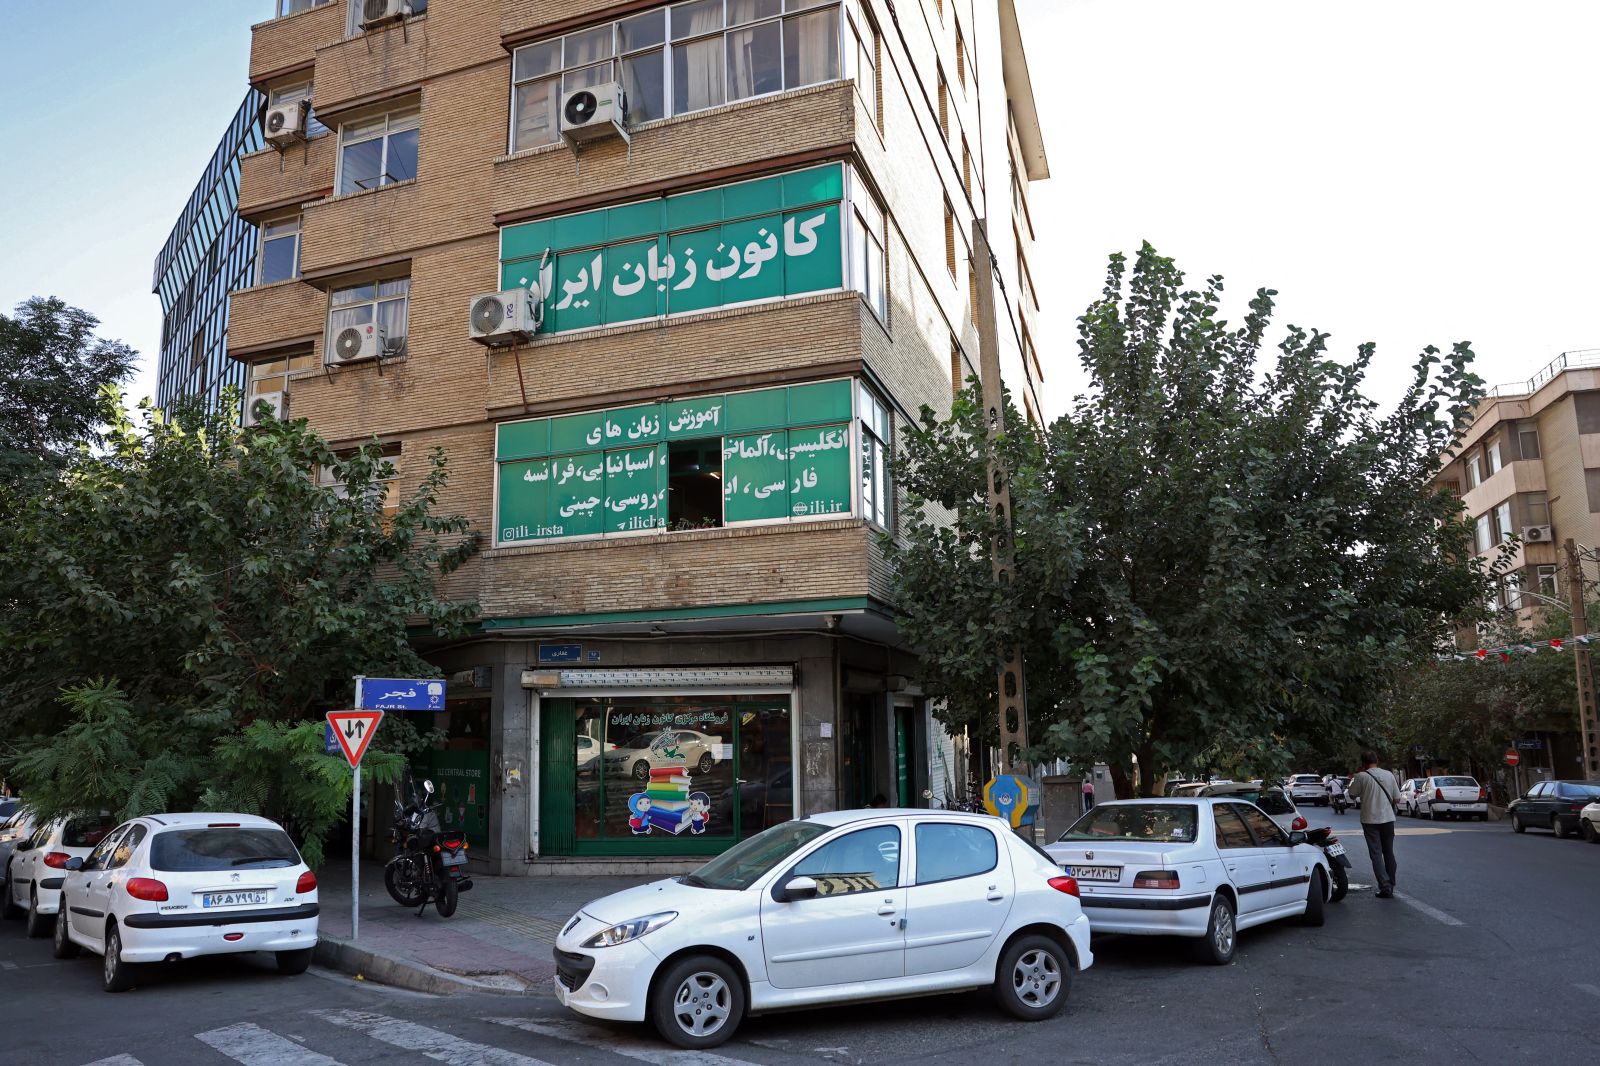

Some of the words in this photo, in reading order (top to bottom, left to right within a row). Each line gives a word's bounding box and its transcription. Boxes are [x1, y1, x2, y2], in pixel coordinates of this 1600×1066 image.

[706, 213, 826, 281] کانون
[612, 244, 697, 297] زبان
[668, 405, 722, 432] آموزش
[586, 420, 622, 445] های
[627, 415, 660, 439] زبان
[559, 494, 601, 517] چینی
[810, 499, 842, 514] ili.ir
[378, 688, 417, 700] فجر
[611, 713, 633, 726] ایران
[632, 714, 651, 726] زبان
[652, 713, 675, 725] کانون
[674, 713, 699, 725] مرکزی
[698, 711, 729, 724] فروشگاه
[444, 768, 465, 777] CENTRAL
[465, 769, 481, 778] STORE
